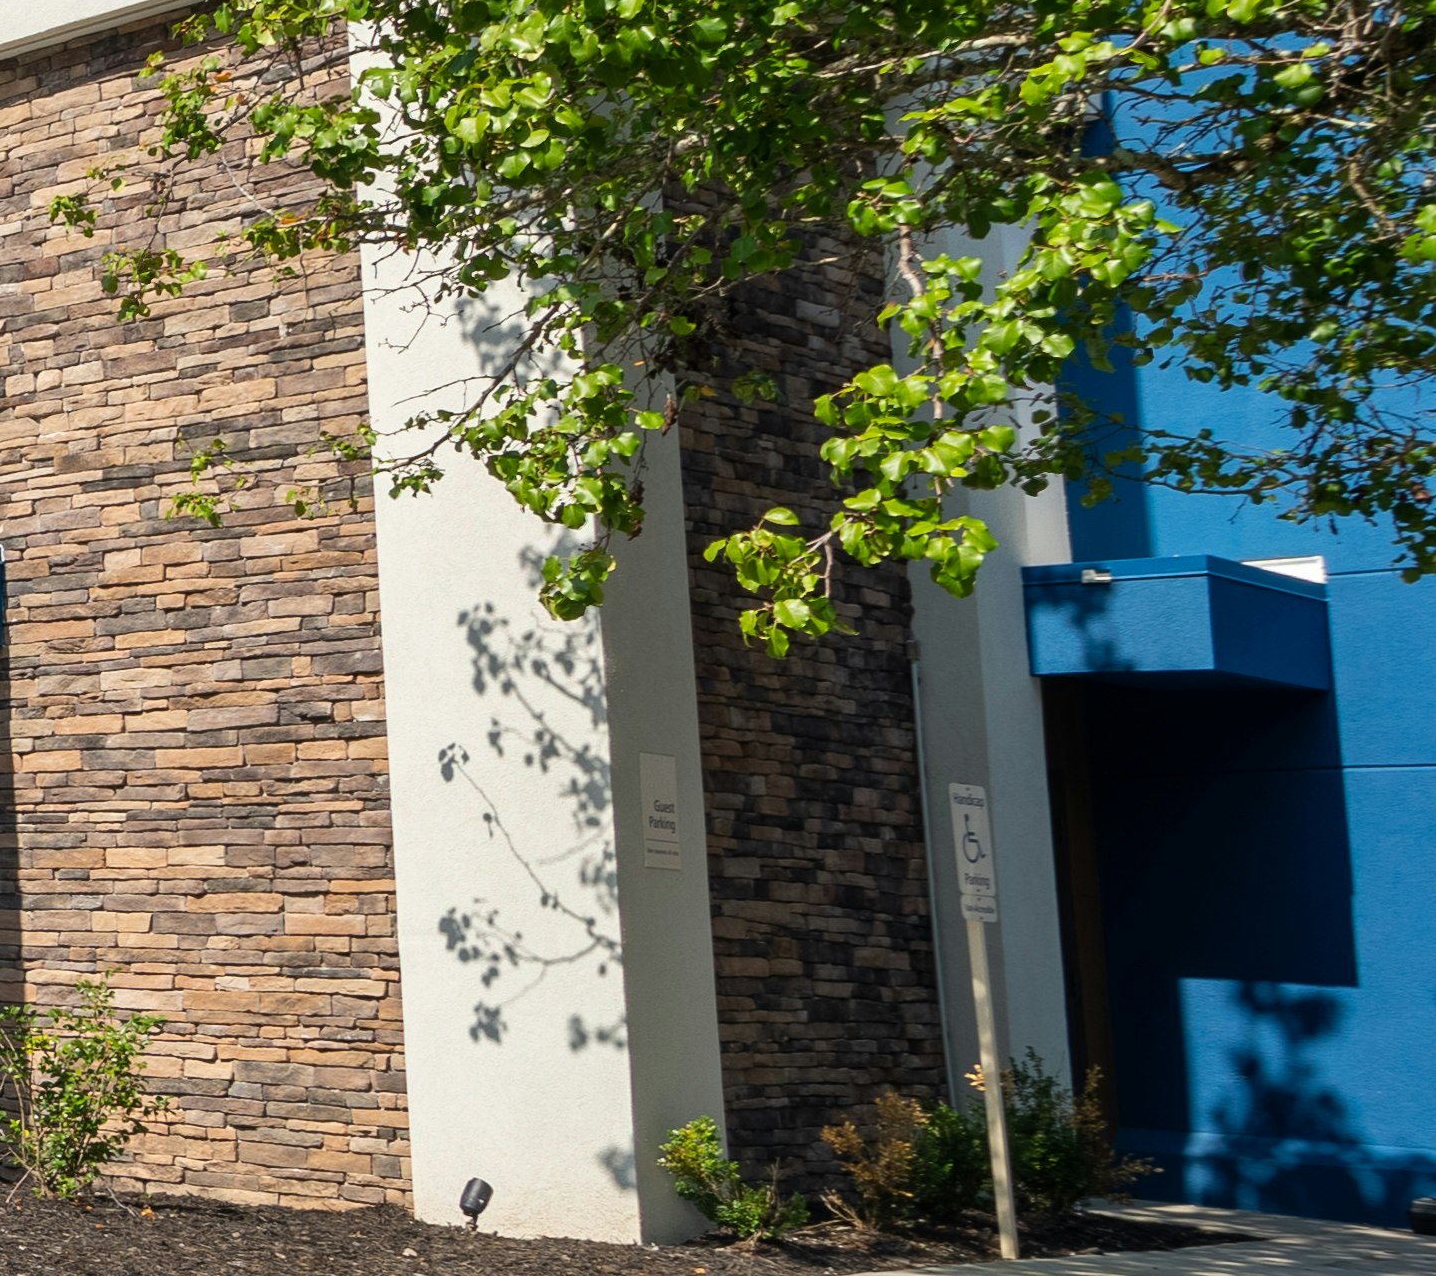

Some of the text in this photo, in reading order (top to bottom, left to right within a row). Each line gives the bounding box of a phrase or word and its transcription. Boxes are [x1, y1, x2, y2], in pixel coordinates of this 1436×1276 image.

[654, 800, 675, 813] Guest
[649, 816, 675, 834] Parking
[964, 873, 990, 890] Parking
